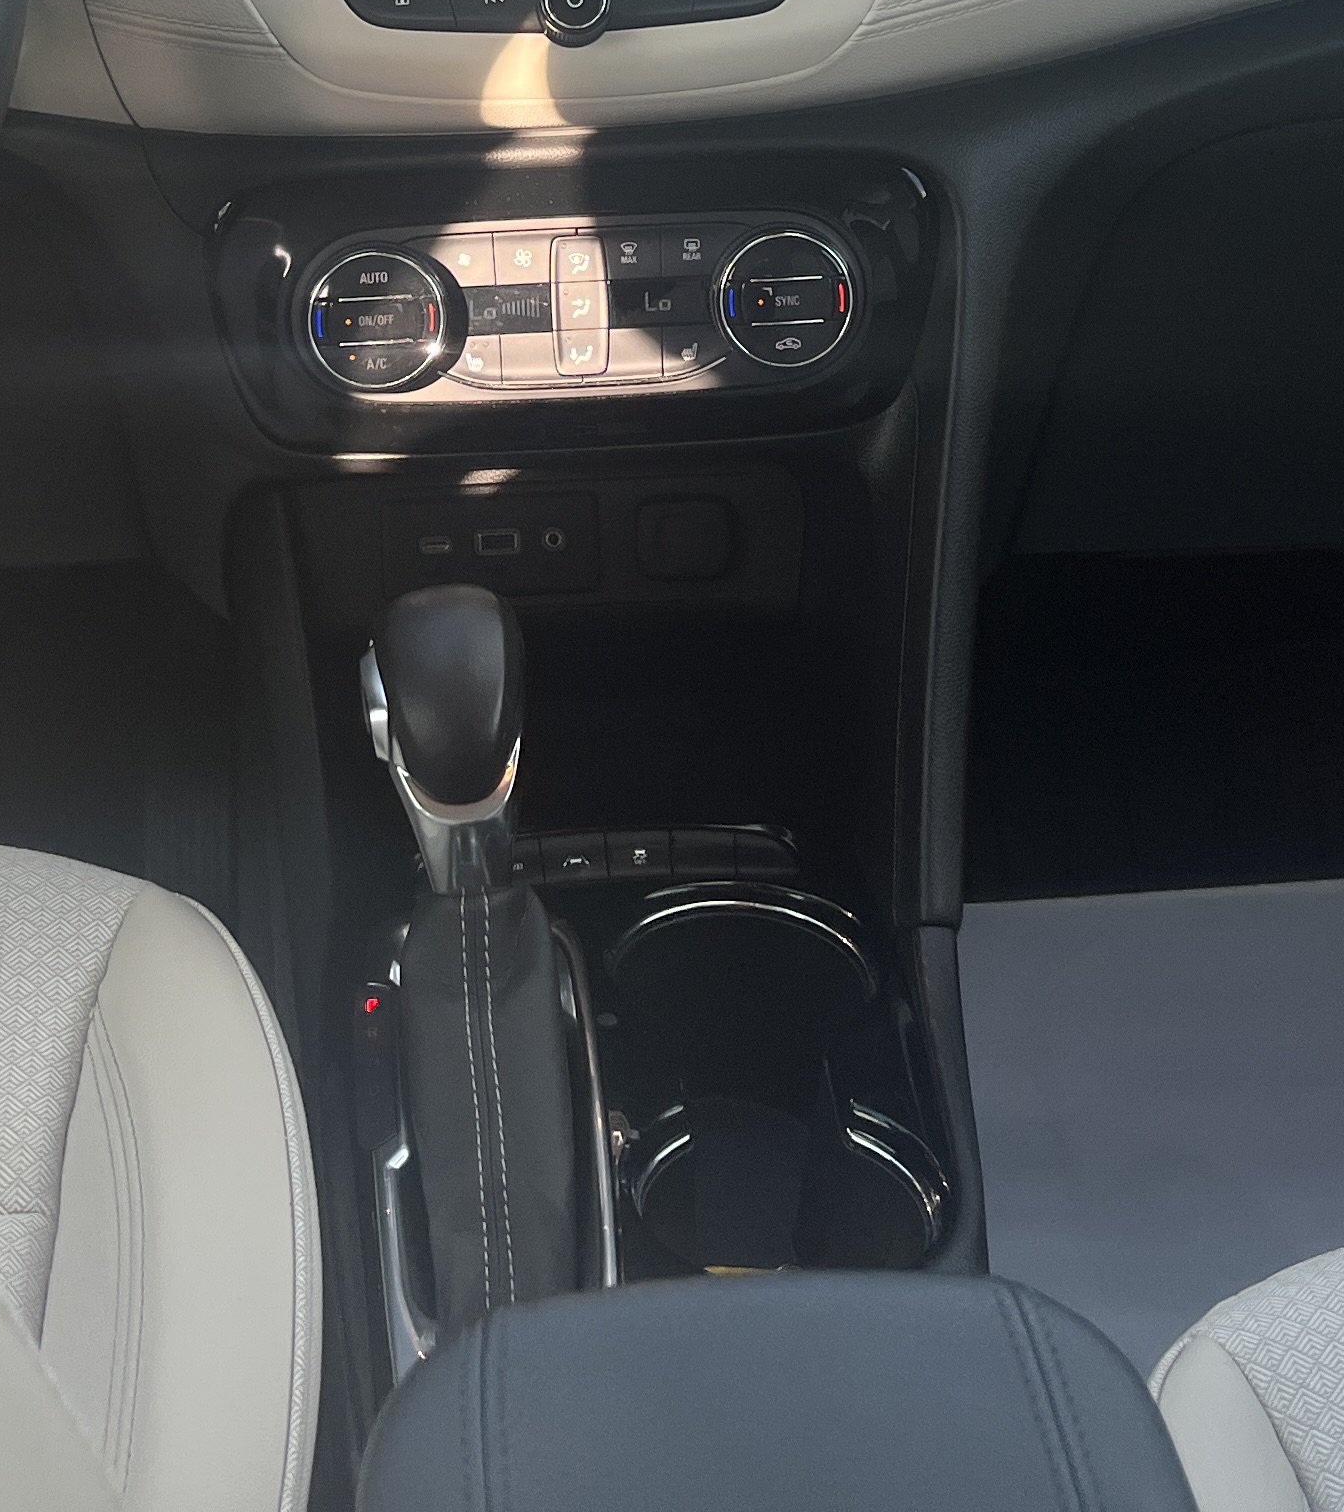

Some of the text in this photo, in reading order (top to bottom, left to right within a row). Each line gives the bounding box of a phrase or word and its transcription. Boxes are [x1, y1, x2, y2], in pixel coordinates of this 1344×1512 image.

[620, 255, 638, 264] MAX
[682, 251, 702, 261] REAR
[359, 271, 389, 285] AUTO
[774, 295, 801, 307] SYNC
[358, 314, 395, 327] ON/OFF
[366, 358, 388, 371] A/C
